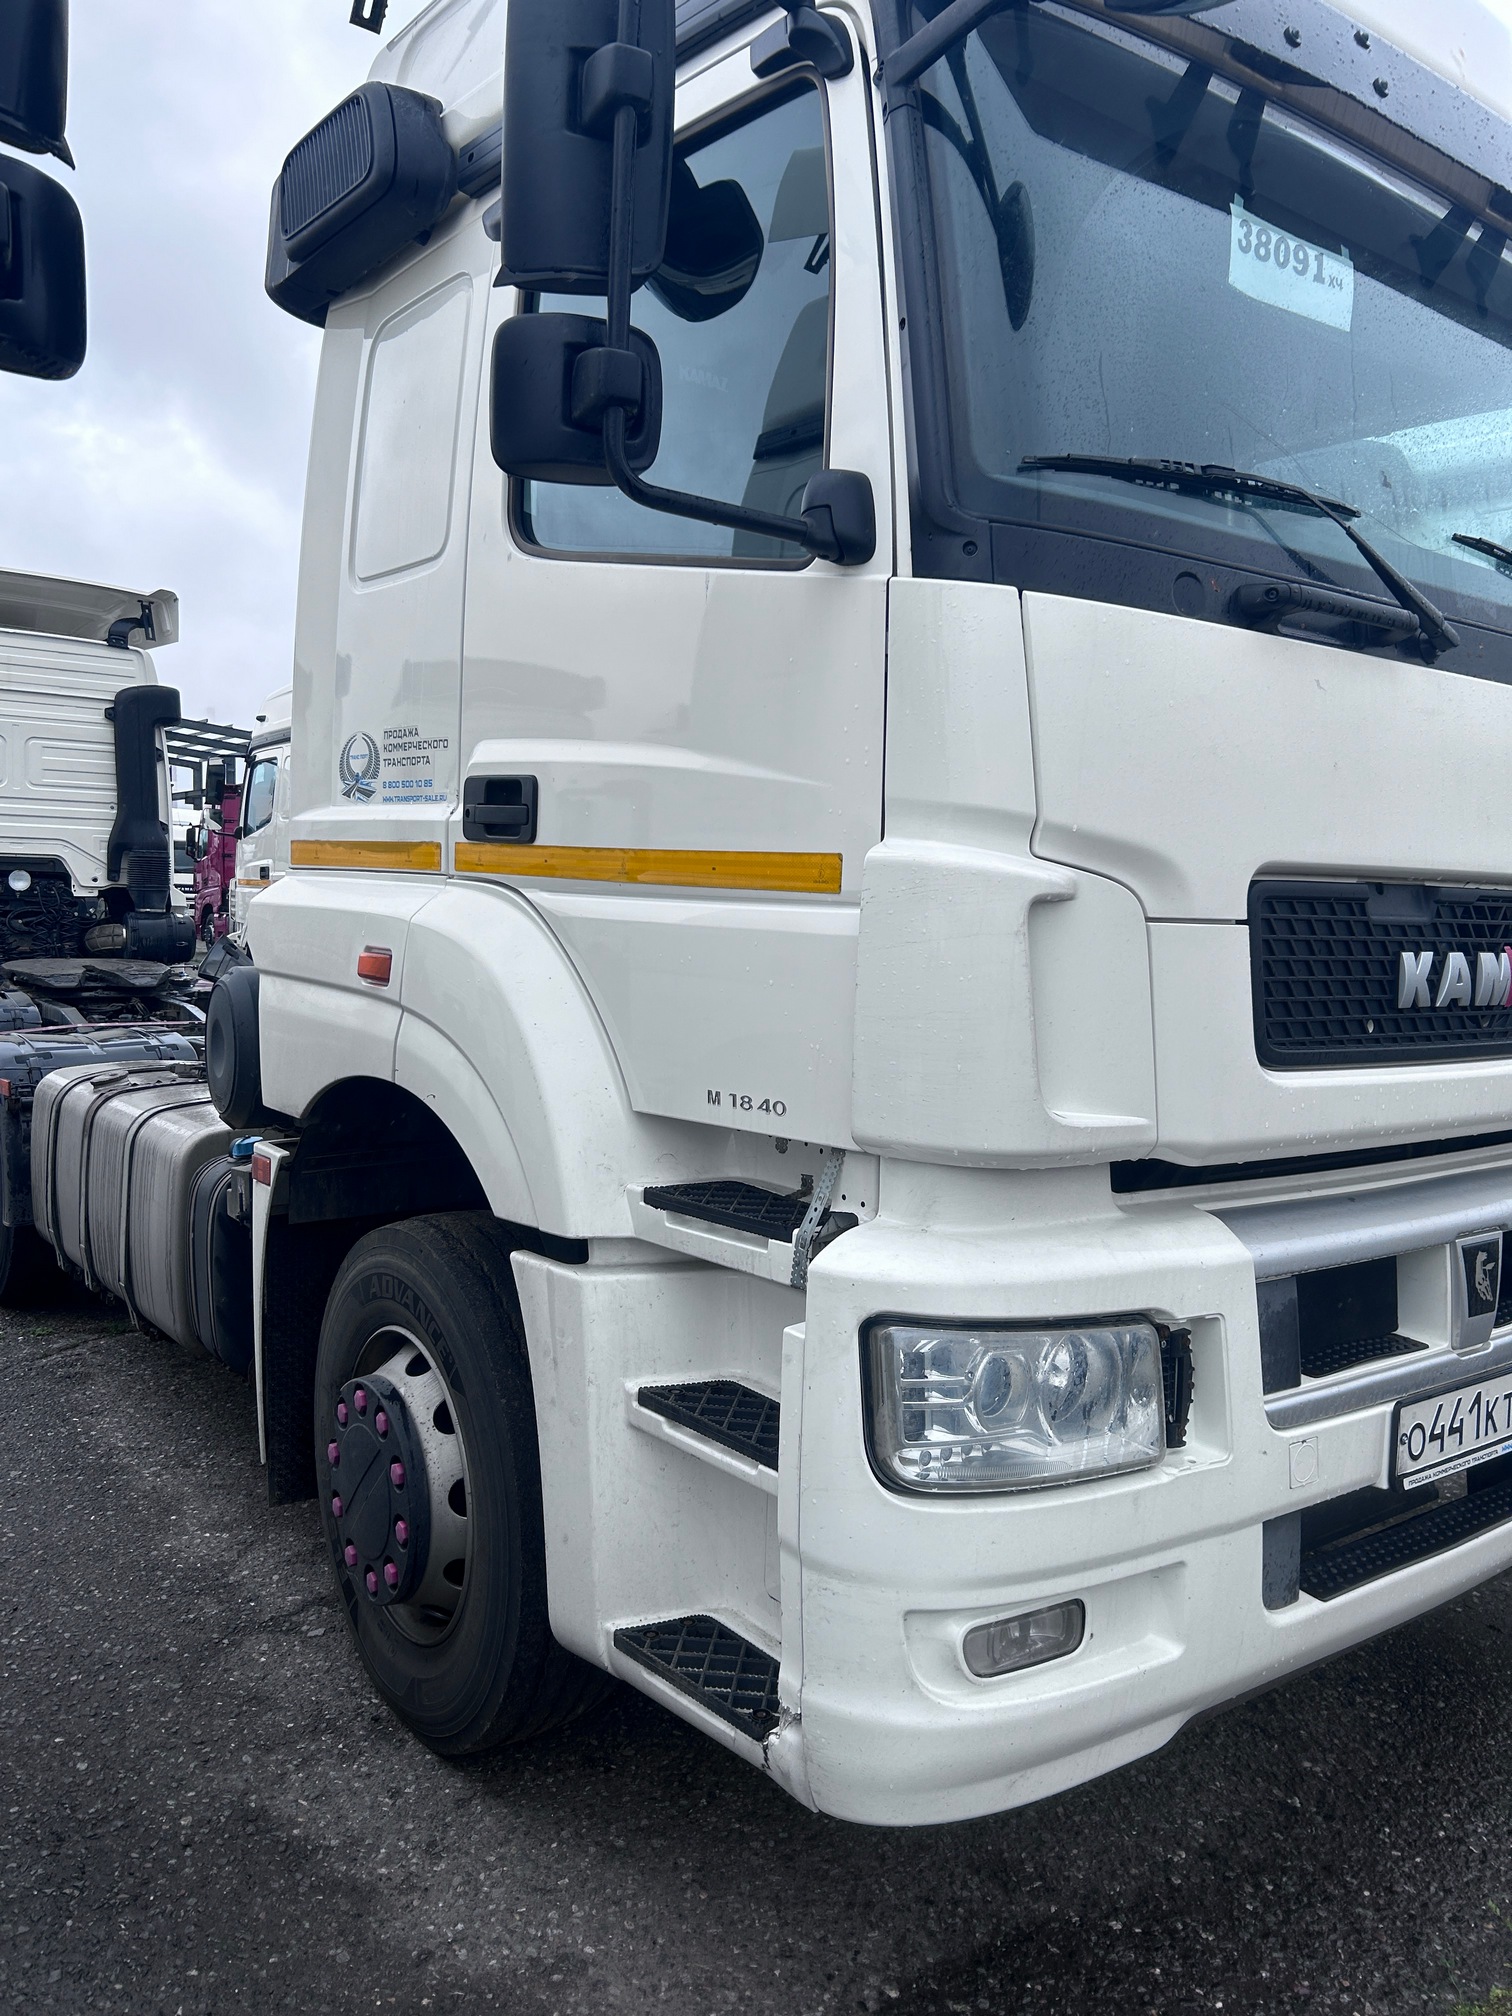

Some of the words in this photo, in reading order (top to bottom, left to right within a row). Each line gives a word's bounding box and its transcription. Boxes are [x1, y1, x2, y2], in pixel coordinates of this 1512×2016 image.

[1237, 218, 1325, 285] 38091
[383, 727, 420, 740] ПРОДАЖА
[383, 738, 449, 753] КОММЕРЧЕСКОГО
[383, 755, 431, 768] ТРАНСПОРТА
[382, 780, 388, 789] 8
[388, 780, 400, 789] 800
[401, 779, 414, 789] 500
[415, 779, 423, 788] 10
[423, 778, 433, 788] 85
[707, 1089, 721, 1106] M
[369, 1274, 450, 1362] ADVANCE
